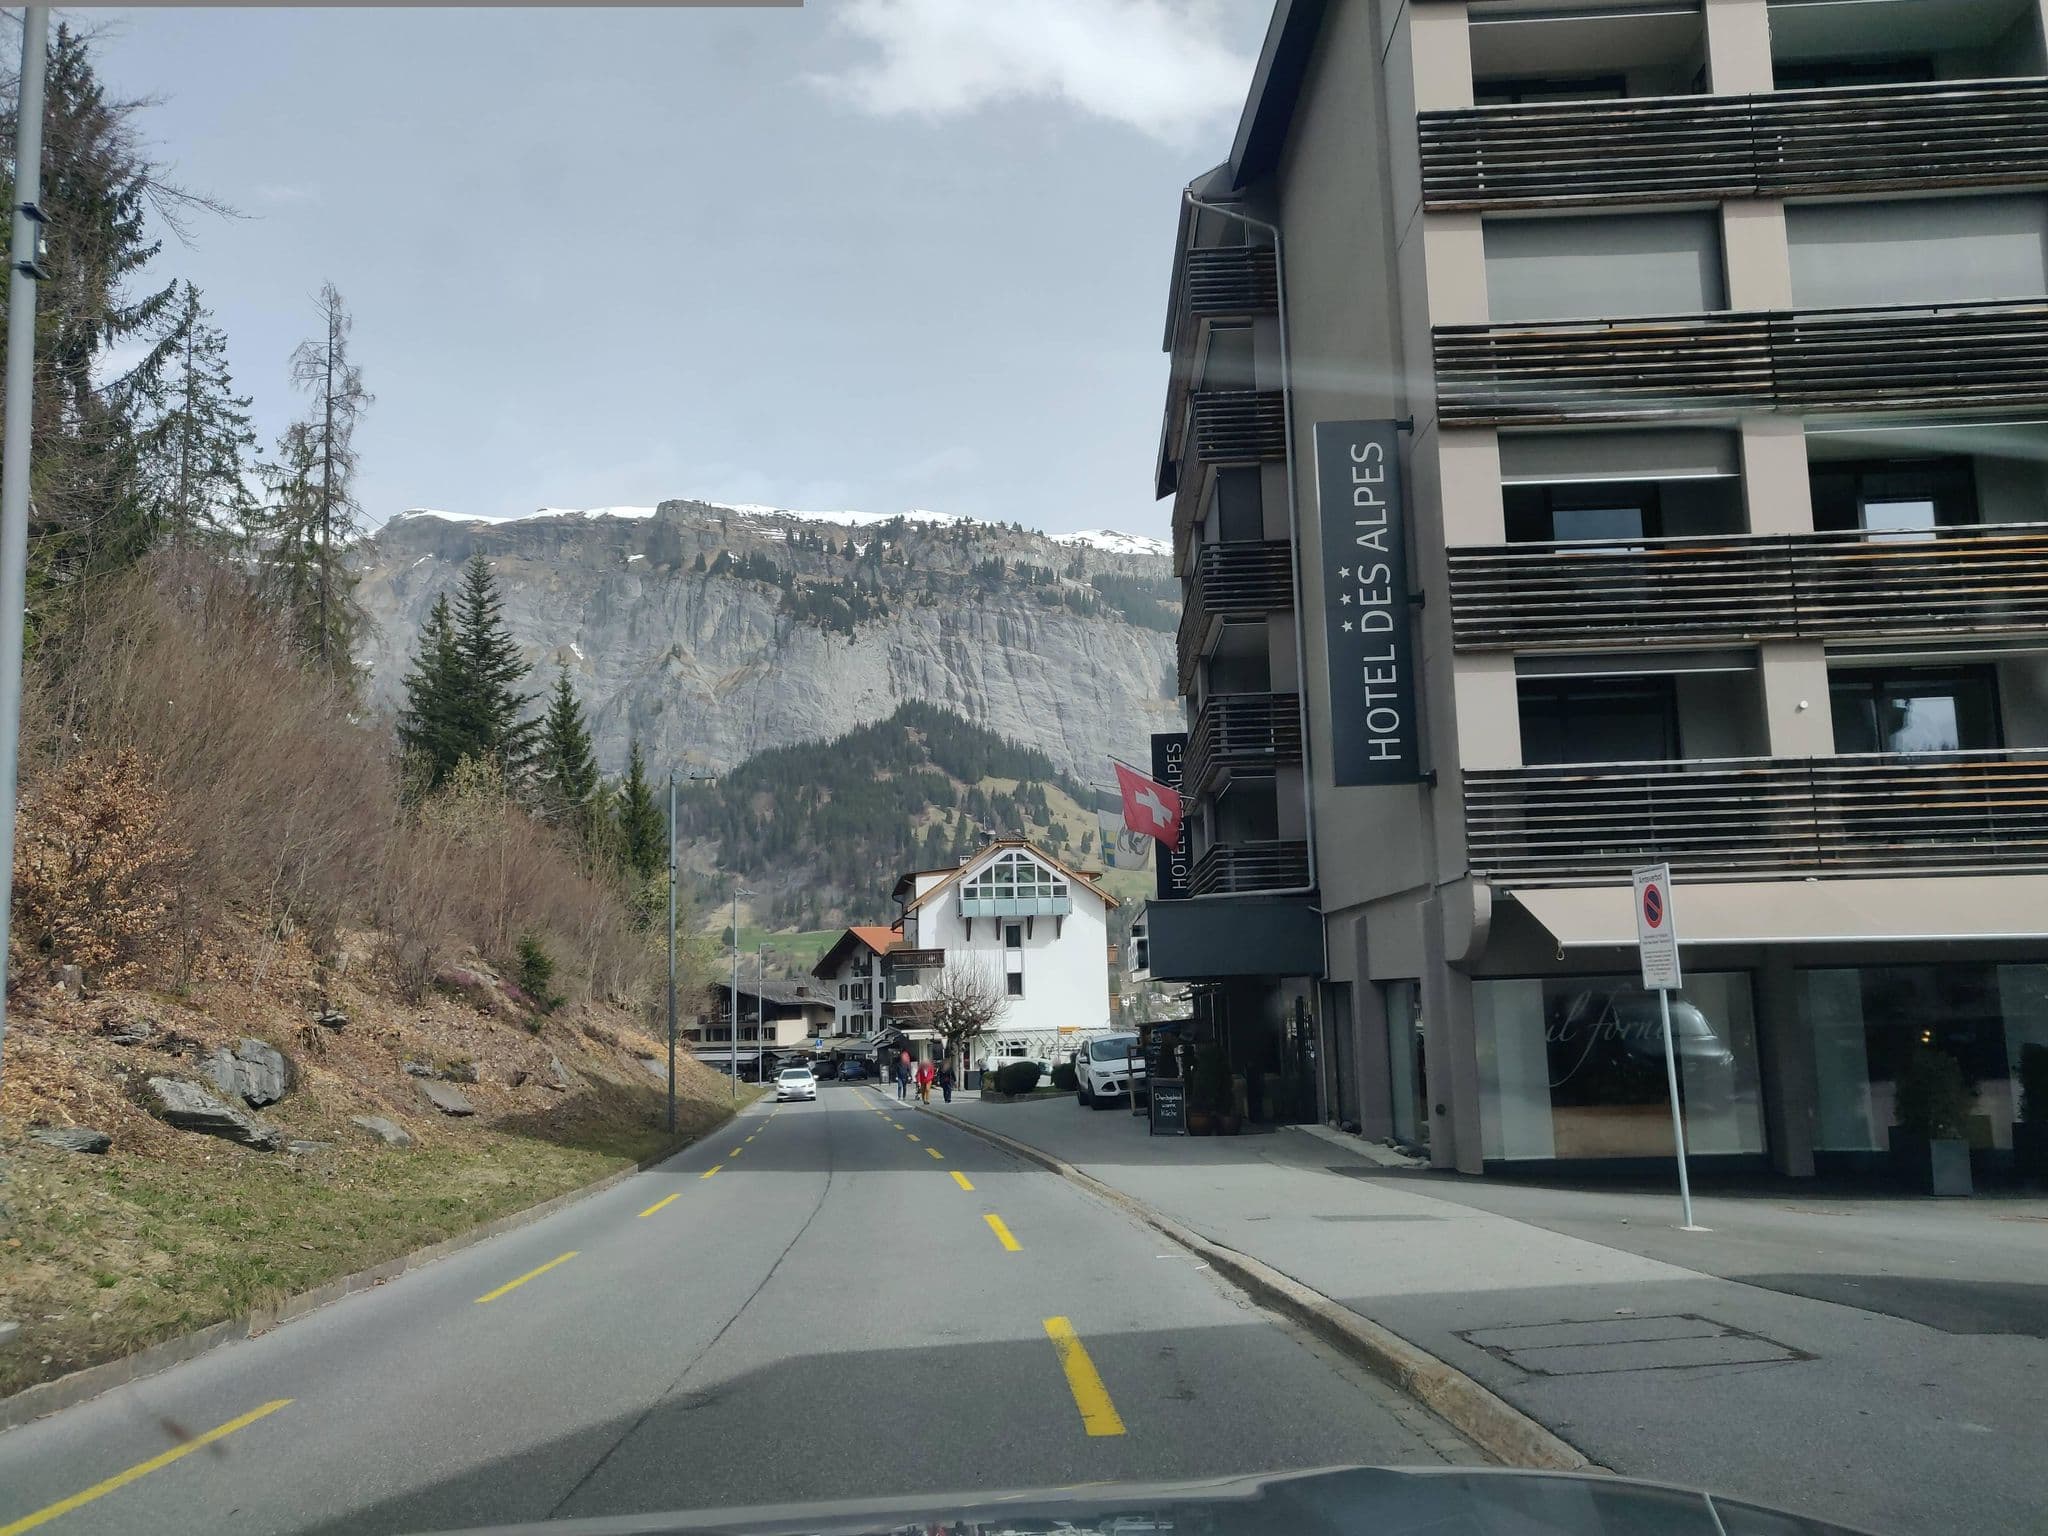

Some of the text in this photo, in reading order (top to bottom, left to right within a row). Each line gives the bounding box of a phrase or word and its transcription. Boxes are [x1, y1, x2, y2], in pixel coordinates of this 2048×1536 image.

[1351, 442, 1401, 761] HOTEL DES ALPES
[1166, 743, 1183, 793] ALPES
